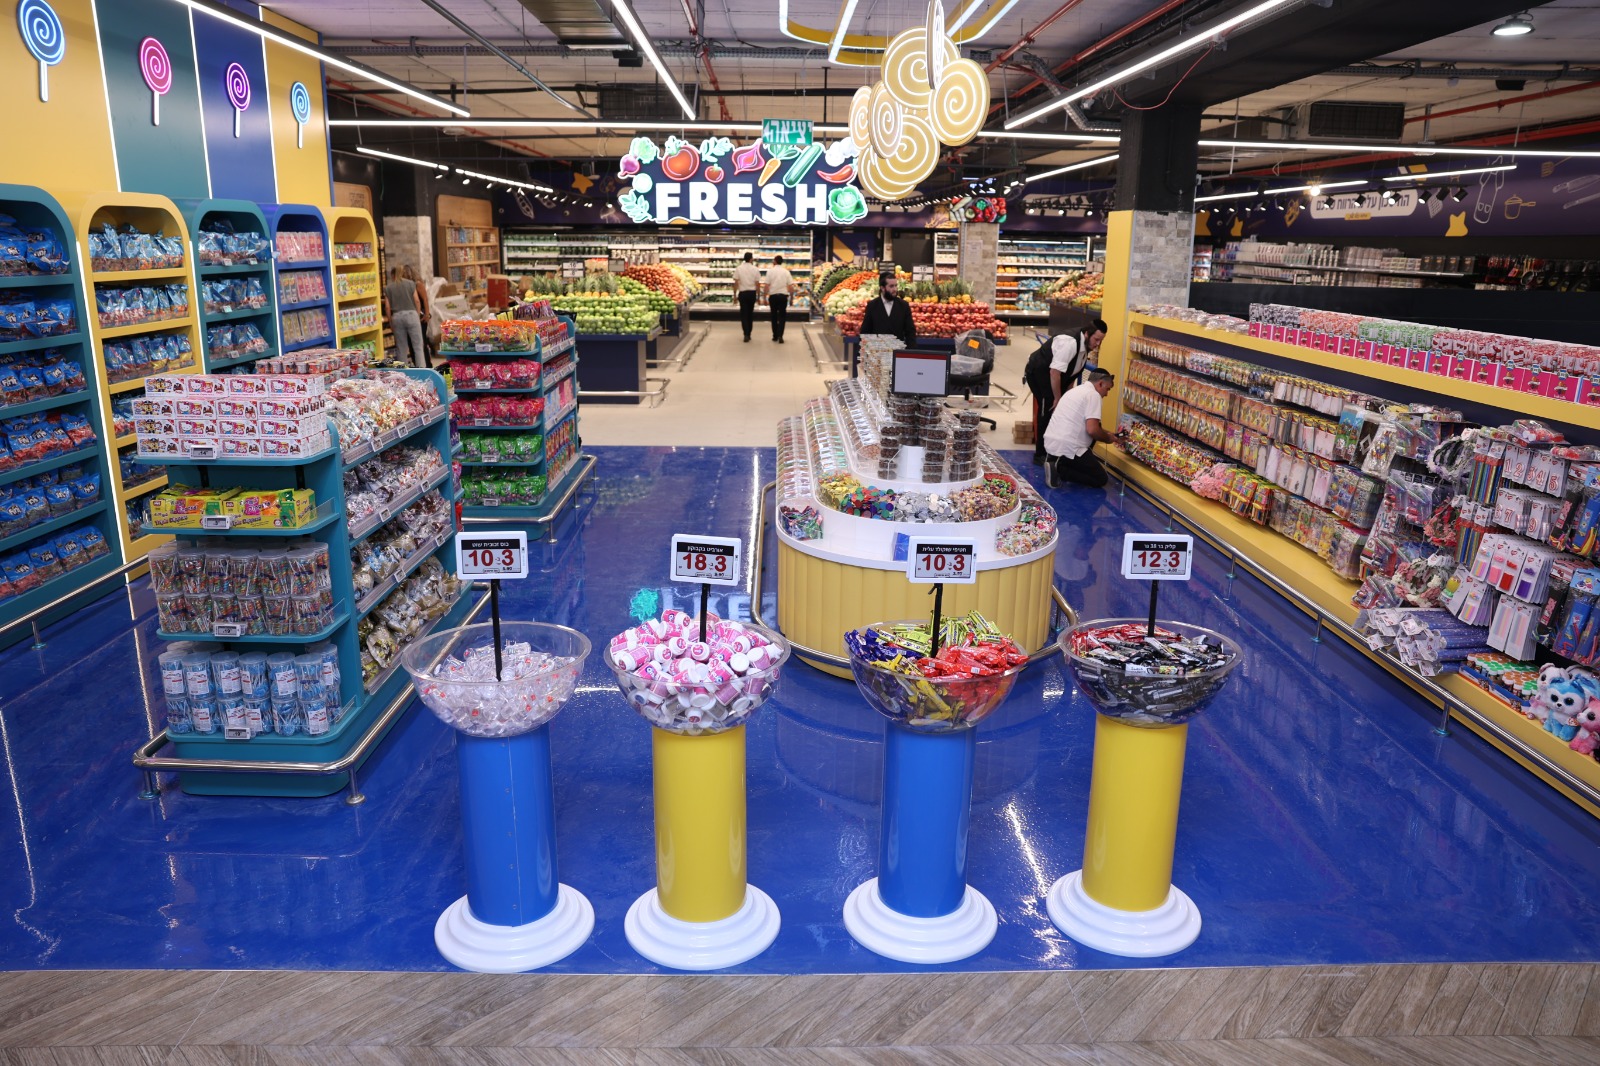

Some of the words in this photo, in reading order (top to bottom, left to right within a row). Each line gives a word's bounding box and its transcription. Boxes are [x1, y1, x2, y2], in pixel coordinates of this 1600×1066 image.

[769, 119, 812, 143] יציאה
[655, 182, 827, 222] FRESH
[1378, 194, 1410, 211] החכון
[468, 549, 492, 567] 10
[502, 548, 514, 566] 3
[682, 553, 706, 571] 18
[714, 555, 726, 572] 3
[922, 554, 946, 571] 10
[954, 554, 964, 571] 3
[1138, 550, 1162, 568] 12
[1168, 551, 1180, 568] 3
